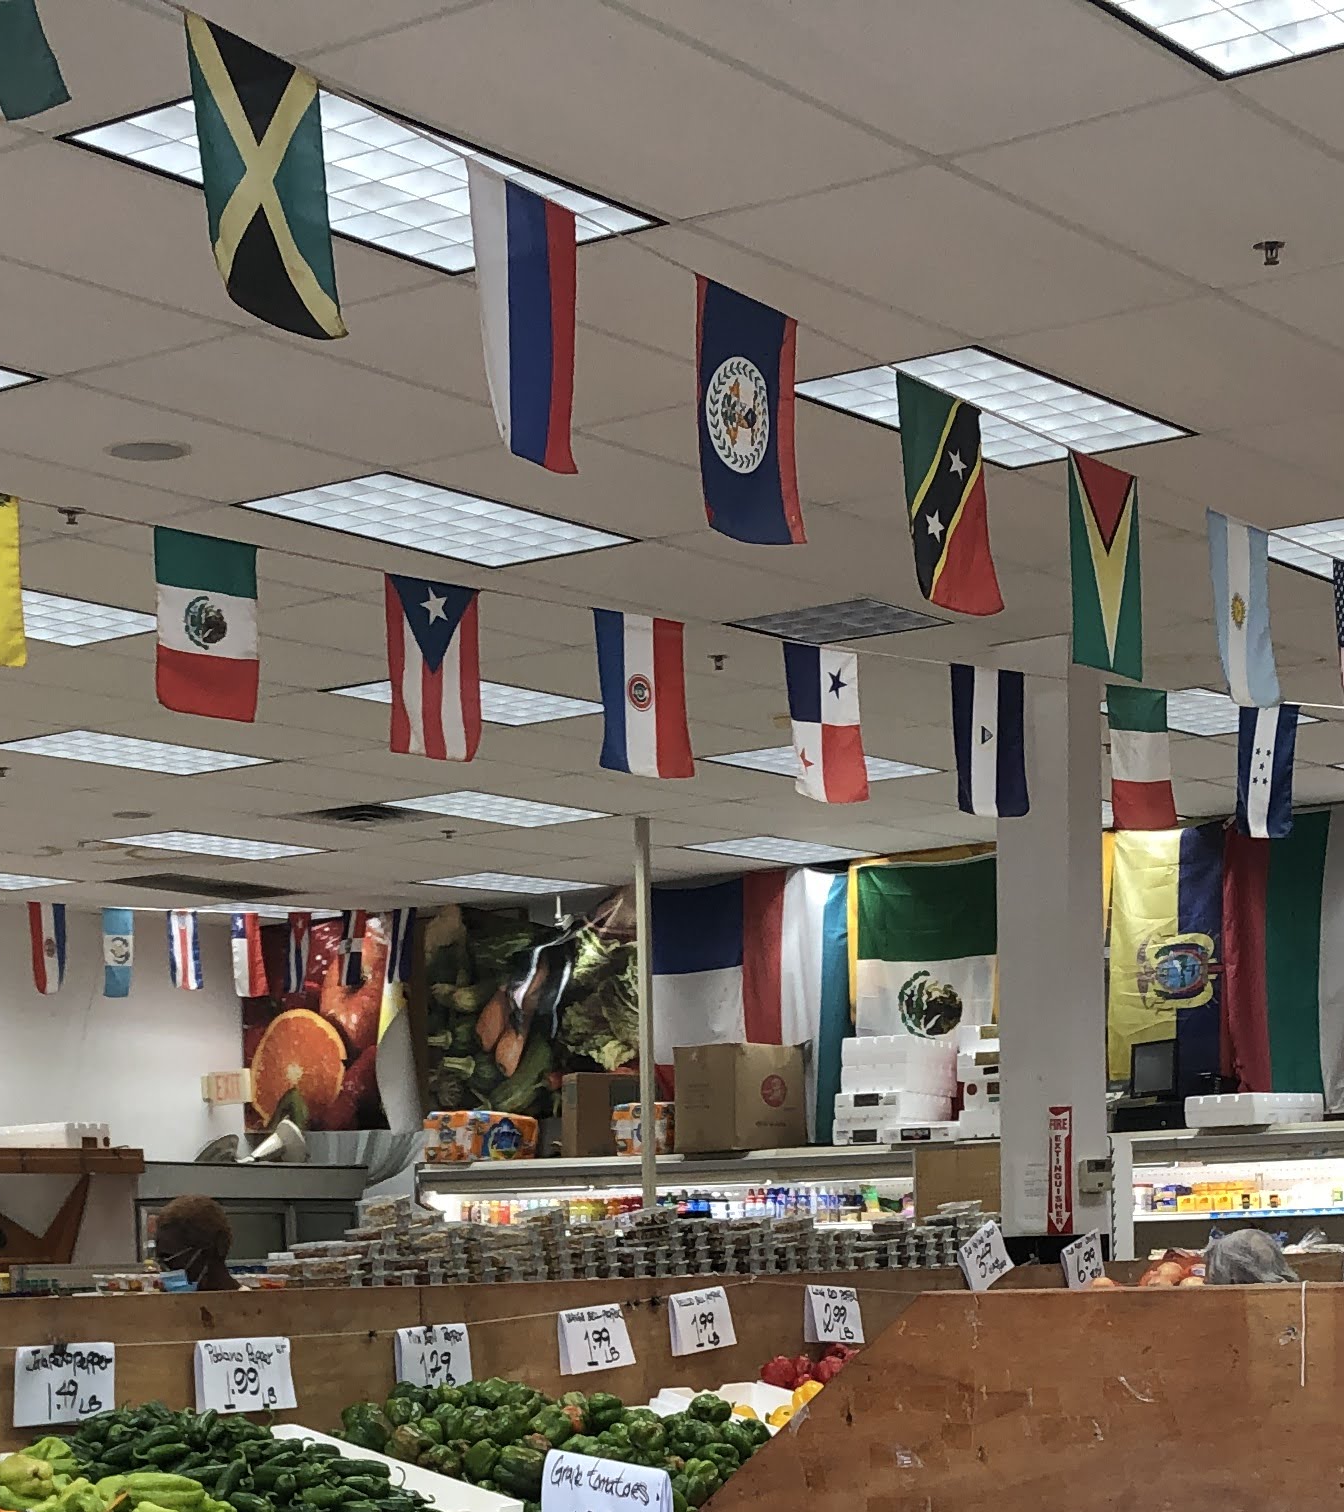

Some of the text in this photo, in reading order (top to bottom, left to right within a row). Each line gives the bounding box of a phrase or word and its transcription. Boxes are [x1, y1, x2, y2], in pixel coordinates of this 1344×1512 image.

[1049, 1118, 1068, 1131] FIRE
[1053, 1134, 1063, 1225] EXTINGUISHER
[604, 1347, 621, 1363] LB
[224, 1367, 261, 1410] 1.99
[79, 1394, 103, 1415] LB
